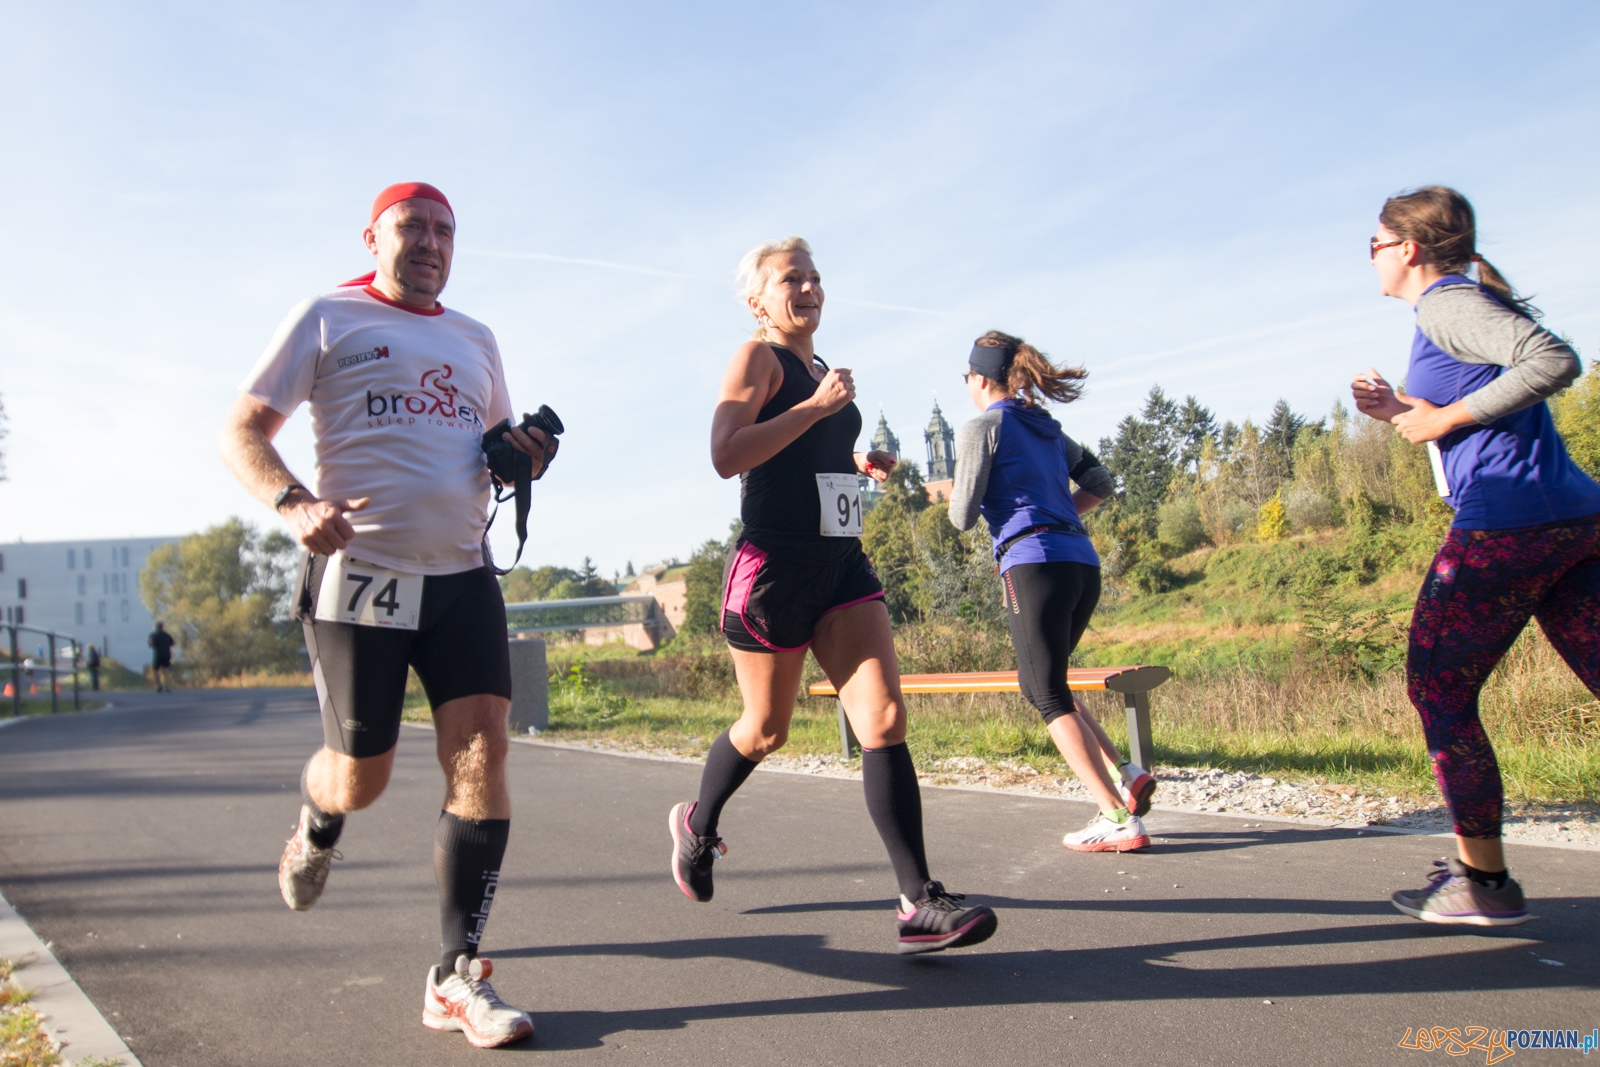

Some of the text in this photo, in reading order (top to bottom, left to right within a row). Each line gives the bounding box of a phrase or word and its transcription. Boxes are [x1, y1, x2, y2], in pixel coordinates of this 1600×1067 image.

[367, 415, 416, 428] sklep
[836, 493, 862, 528] 91
[346, 573, 400, 617] 74
